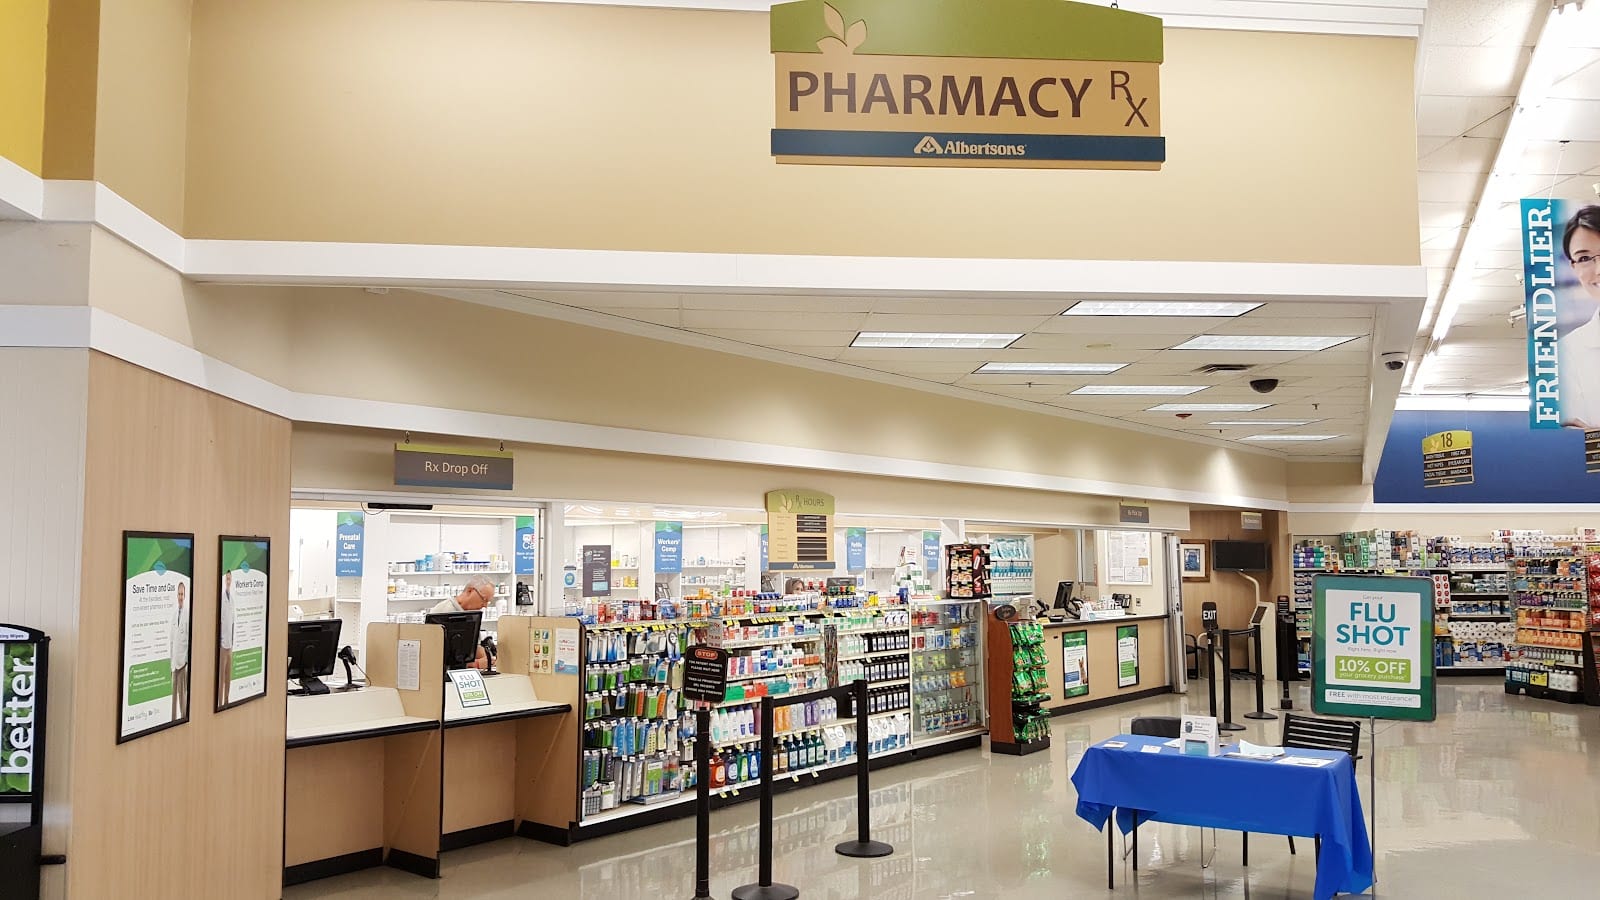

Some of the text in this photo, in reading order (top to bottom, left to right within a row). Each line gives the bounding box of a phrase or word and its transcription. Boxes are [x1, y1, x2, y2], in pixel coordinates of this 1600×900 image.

[788, 70, 1093, 118] PHARMACY
[944, 141, 1025, 156] Albertsons
[1441, 432, 1453, 448] 18
[425, 461, 488, 476] Rx Drop Off
[803, 497, 825, 507] HOURS
[132, 584, 144, 594] Save
[146, 584, 157, 592] Time
[167, 584, 175, 592] Gas
[1203, 610, 1216, 620] EXIT
[1350, 602, 1396, 623] FLU
[1336, 624, 1410, 646] SHOT
[1339, 659, 1406, 674] 10% OFF
[459, 680, 480, 688] SHOT
[1, 655, 36, 774] better.
